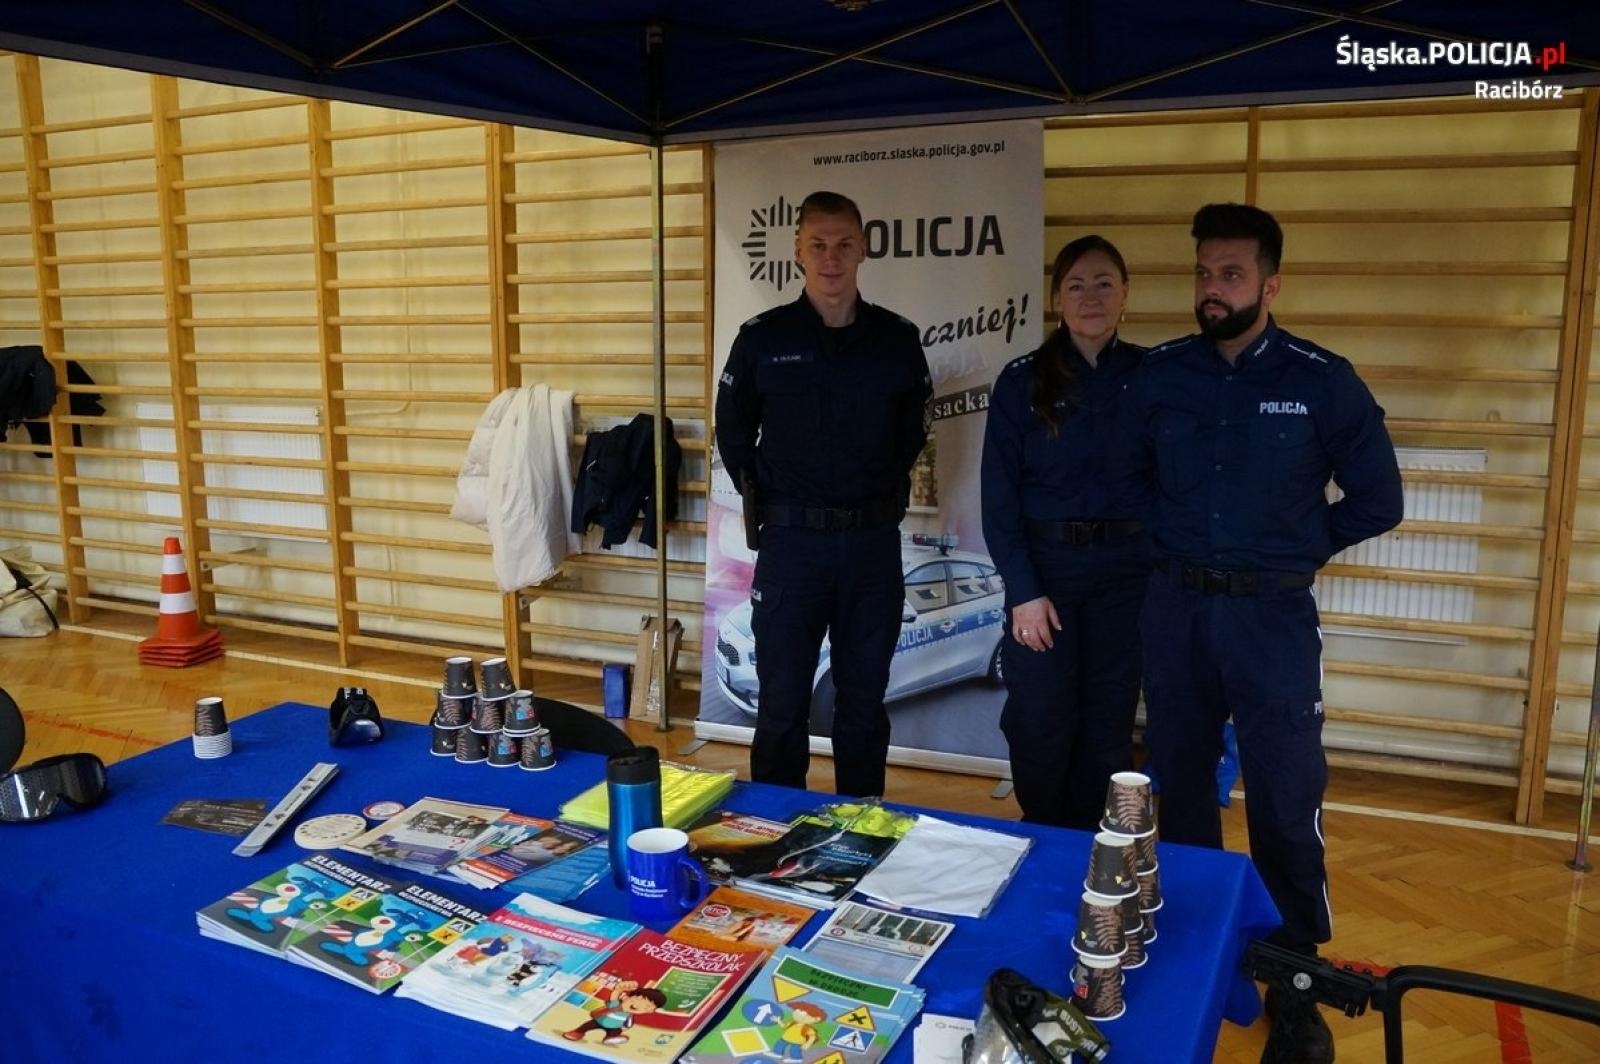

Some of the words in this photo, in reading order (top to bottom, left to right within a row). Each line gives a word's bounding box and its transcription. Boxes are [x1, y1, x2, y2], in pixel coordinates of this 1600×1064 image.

[813, 141, 1005, 166] www.raciborz.slaska.policja.gov.pl
[863, 215, 1005, 259] OLICJA
[921, 294, 1028, 347] czniej!
[933, 391, 990, 419] sacka
[1259, 401, 1309, 416] POLICJA
[311, 855, 393, 893] ELEMENTARZ
[405, 884, 489, 923] ELEMENTARZ
[565, 936, 600, 950] FERIE
[660, 939, 745, 963] BEZPIECZNY
[638, 943, 746, 972] PRZEDSZKOLAK
